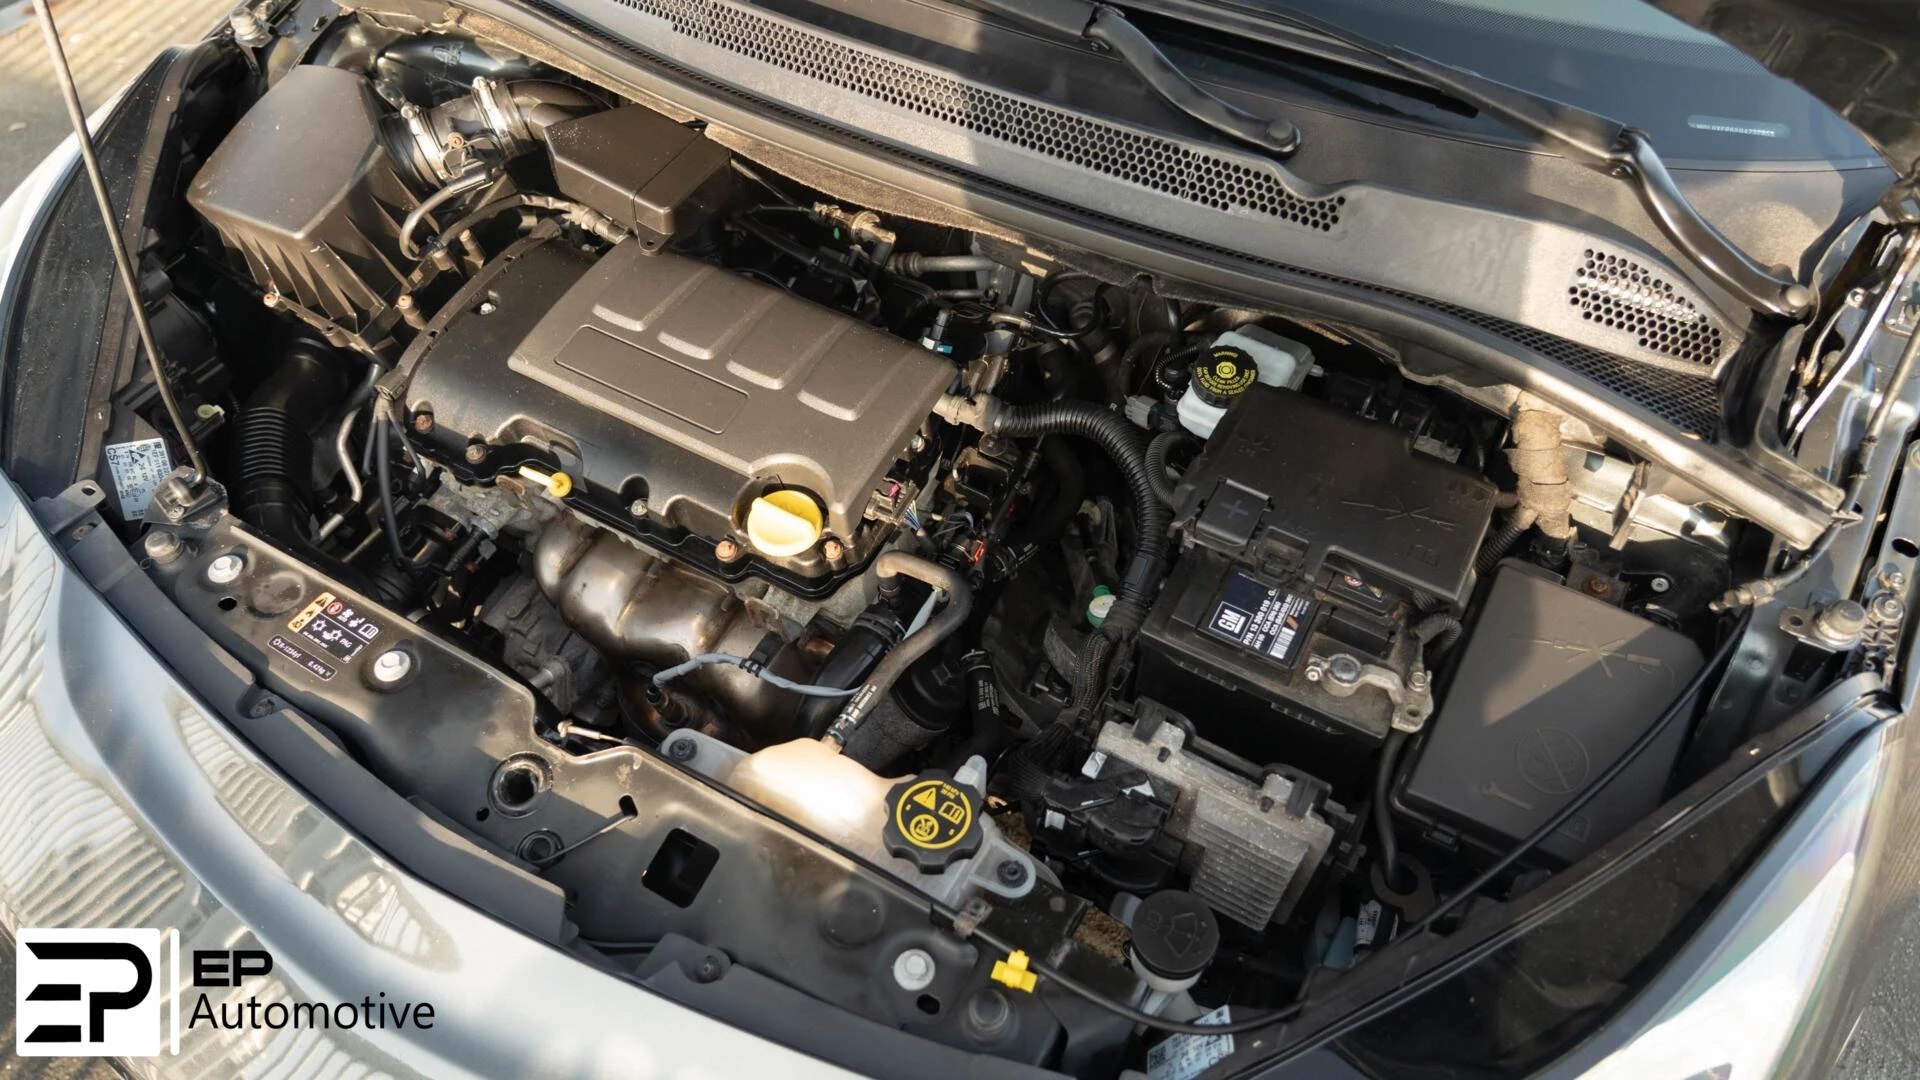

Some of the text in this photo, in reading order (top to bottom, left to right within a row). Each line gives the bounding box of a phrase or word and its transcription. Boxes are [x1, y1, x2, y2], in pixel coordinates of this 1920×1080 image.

[107, 448, 120, 466] CS7
[1218, 608, 1241, 632] GM
[1262, 621, 1272, 632] CCA
[1243, 632, 1254, 646] P/N
[1250, 624, 1259, 632] 13
[1269, 624, 1279, 636] CCA
